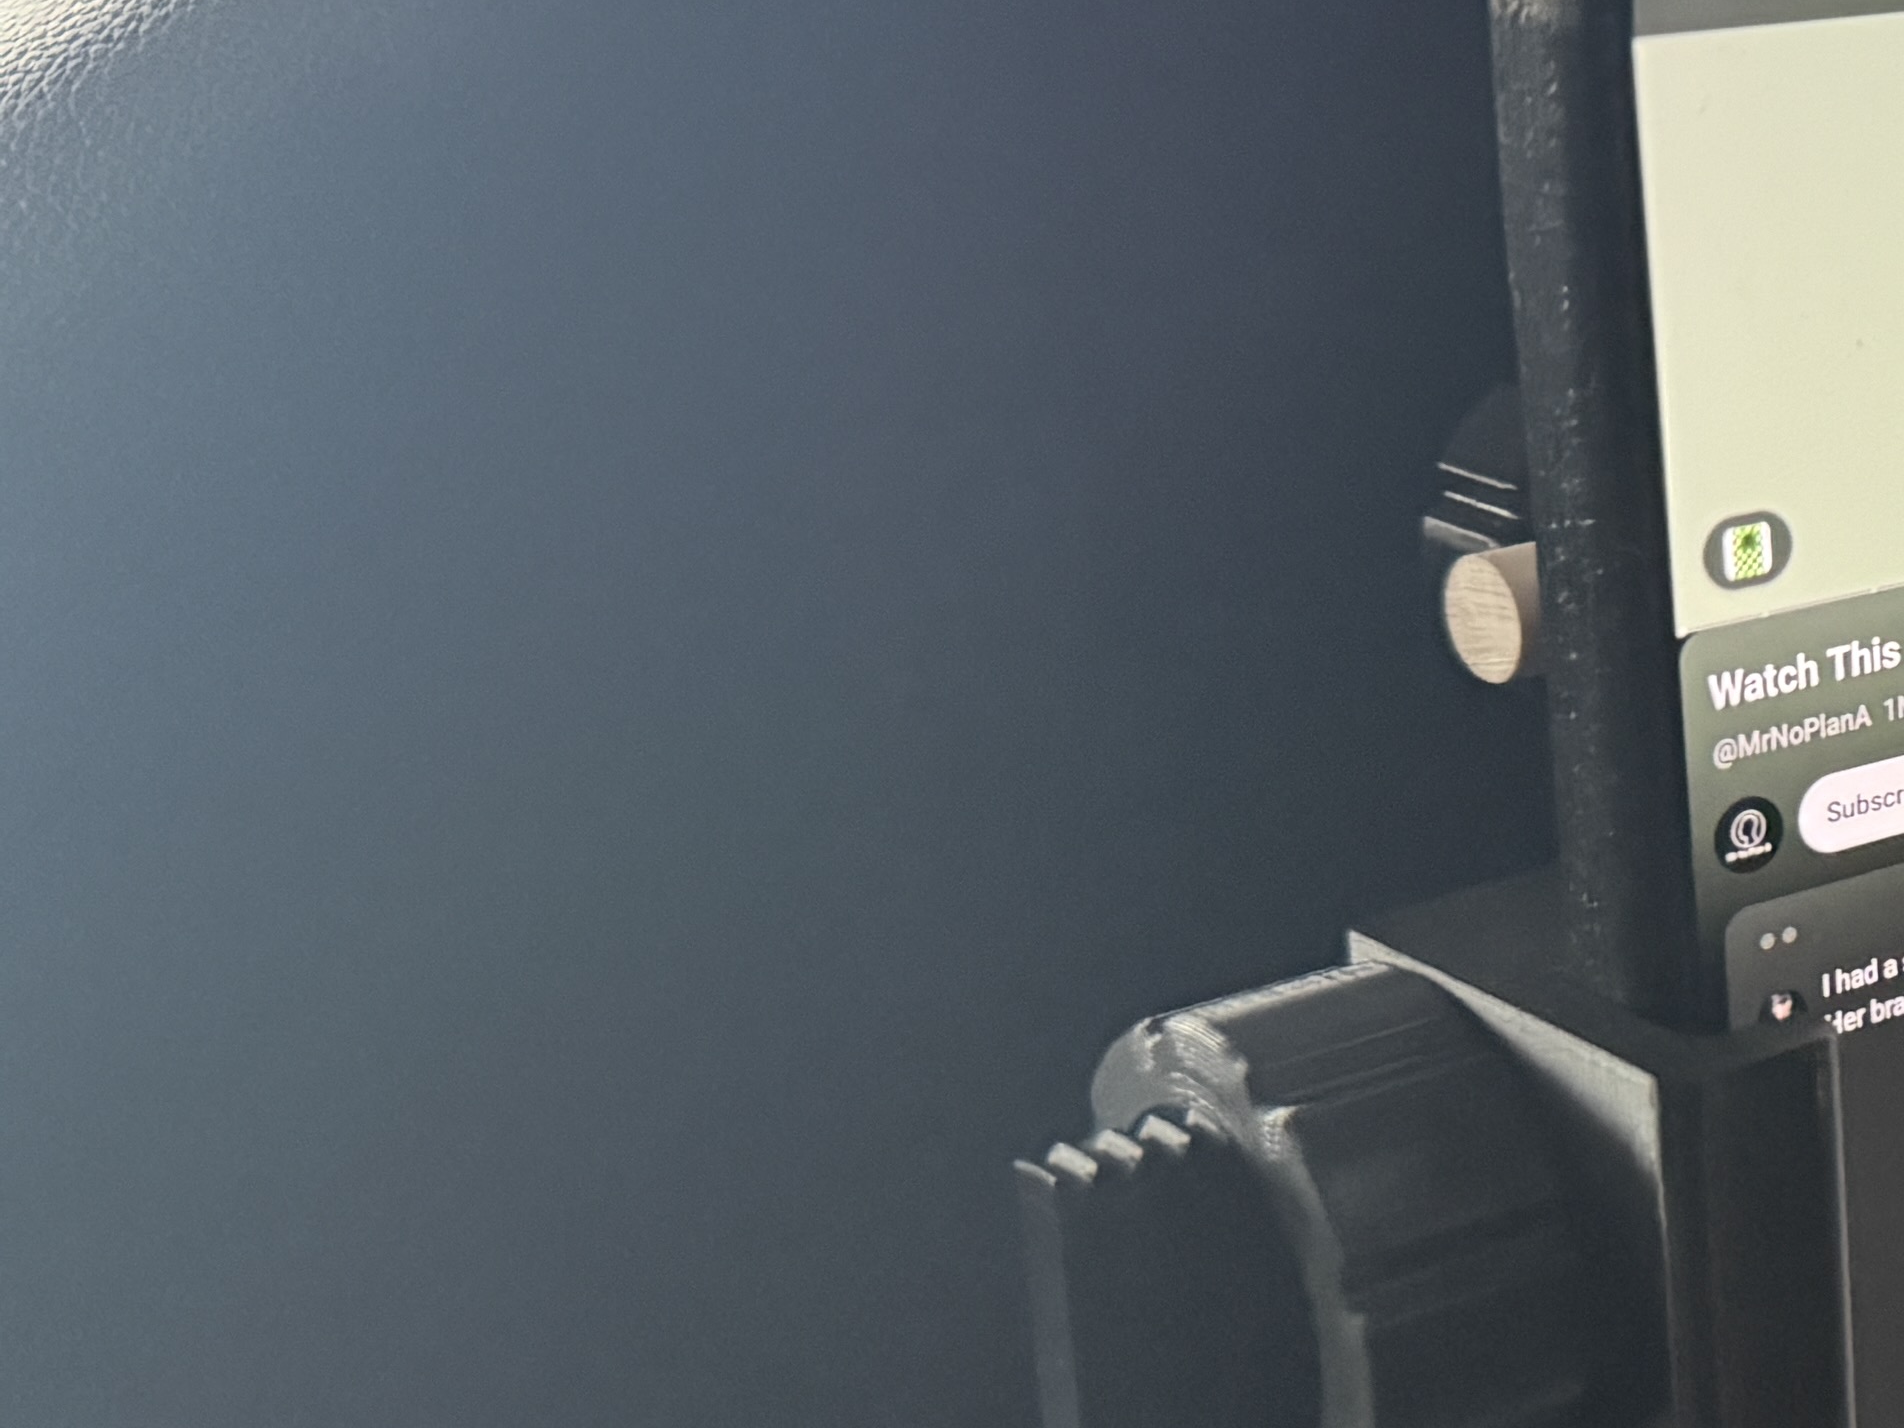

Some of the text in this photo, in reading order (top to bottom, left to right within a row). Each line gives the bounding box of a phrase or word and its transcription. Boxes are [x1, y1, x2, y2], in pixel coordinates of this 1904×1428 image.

[1707, 652, 1819, 711] Watch
[1826, 636, 1901, 682] This
[1712, 703, 1873, 770] @MrNoPlanA
[1821, 973, 1830, 998] I
[1835, 958, 1879, 994] had
[1883, 957, 1898, 980] a
